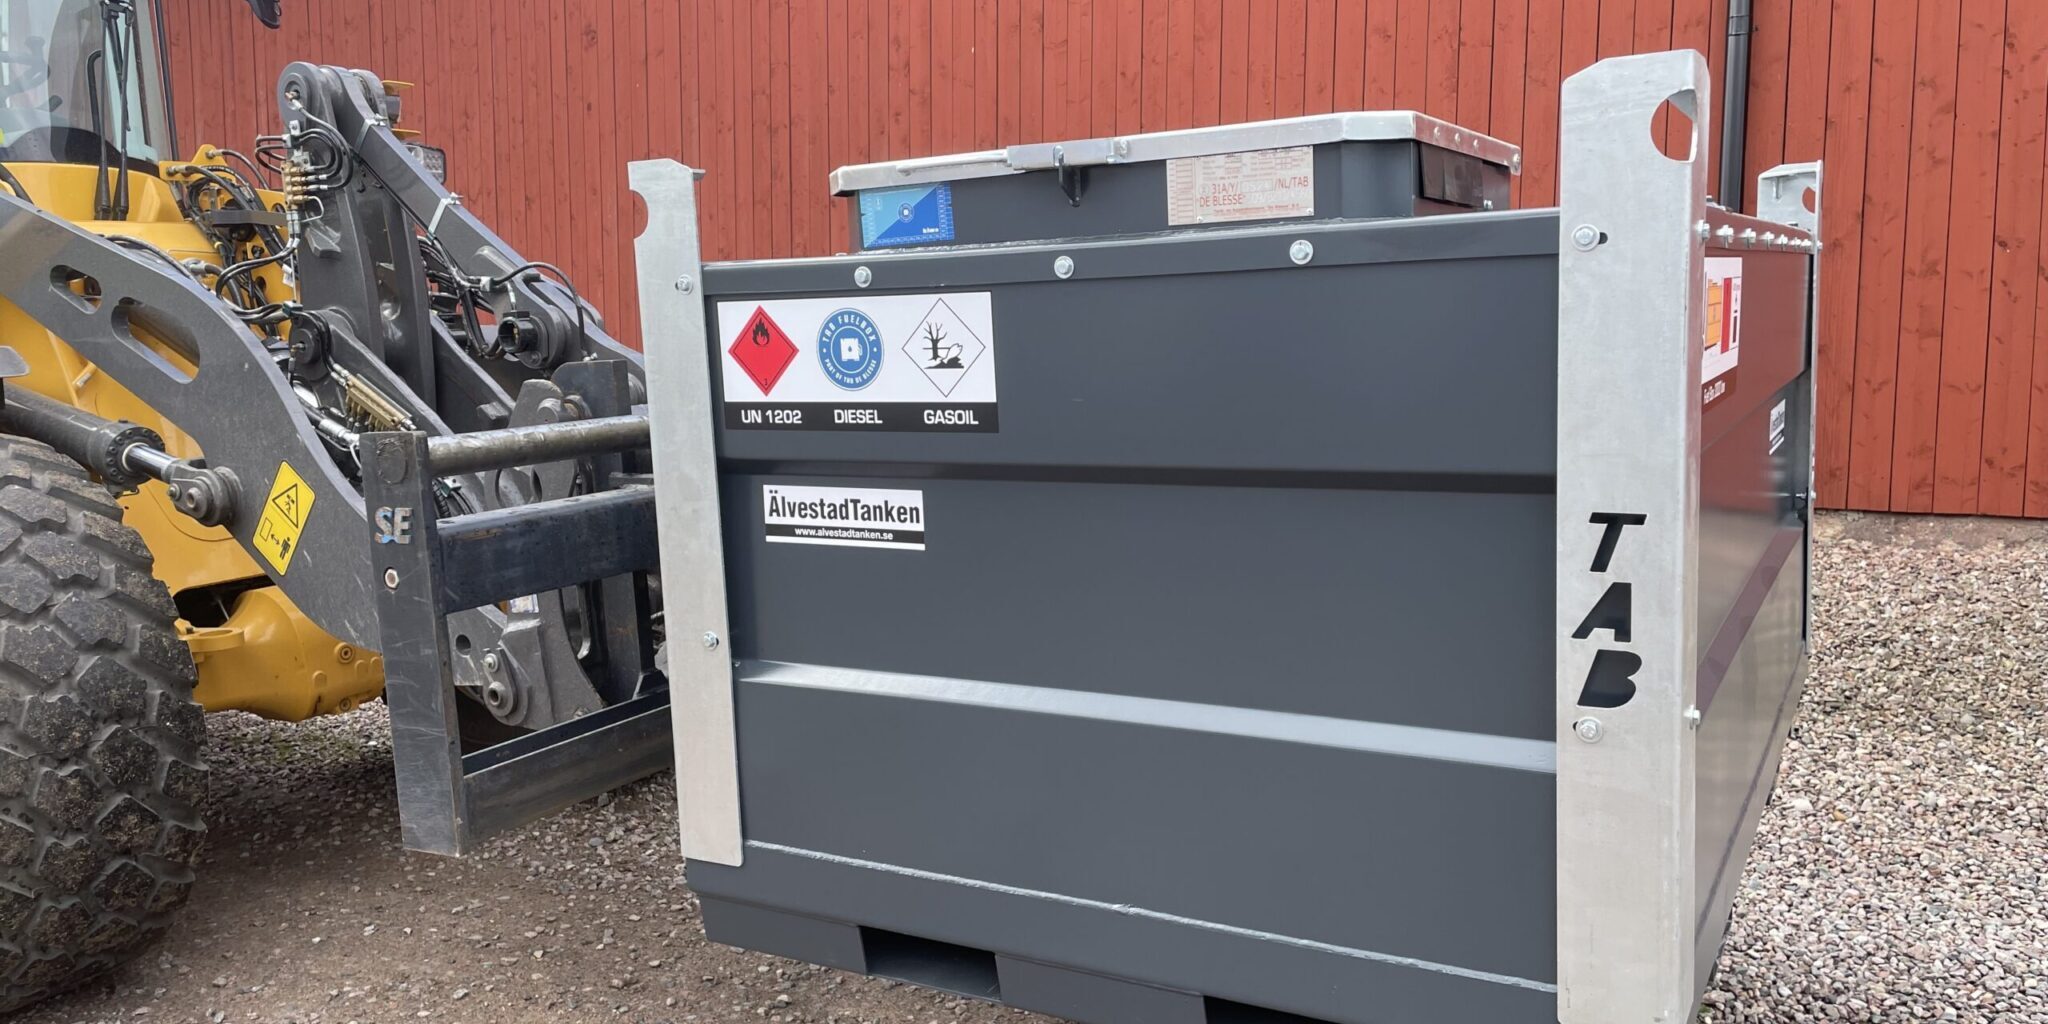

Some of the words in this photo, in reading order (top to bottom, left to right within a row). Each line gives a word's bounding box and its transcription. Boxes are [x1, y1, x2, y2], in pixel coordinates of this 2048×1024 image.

[1274, 175, 1309, 191] /NL/TAB
[838, 314, 876, 341] FUELBOX
[741, 409, 762, 424] UN
[765, 409, 802, 424] 1202
[834, 409, 883, 424] DIESEL
[923, 409, 979, 425] GASOIL
[768, 489, 920, 524] ÄlvestadTanken
[374, 506, 414, 545] SE
[794, 527, 894, 541] www.alvestadtanken.se
[1571, 512, 1648, 708] TAB
